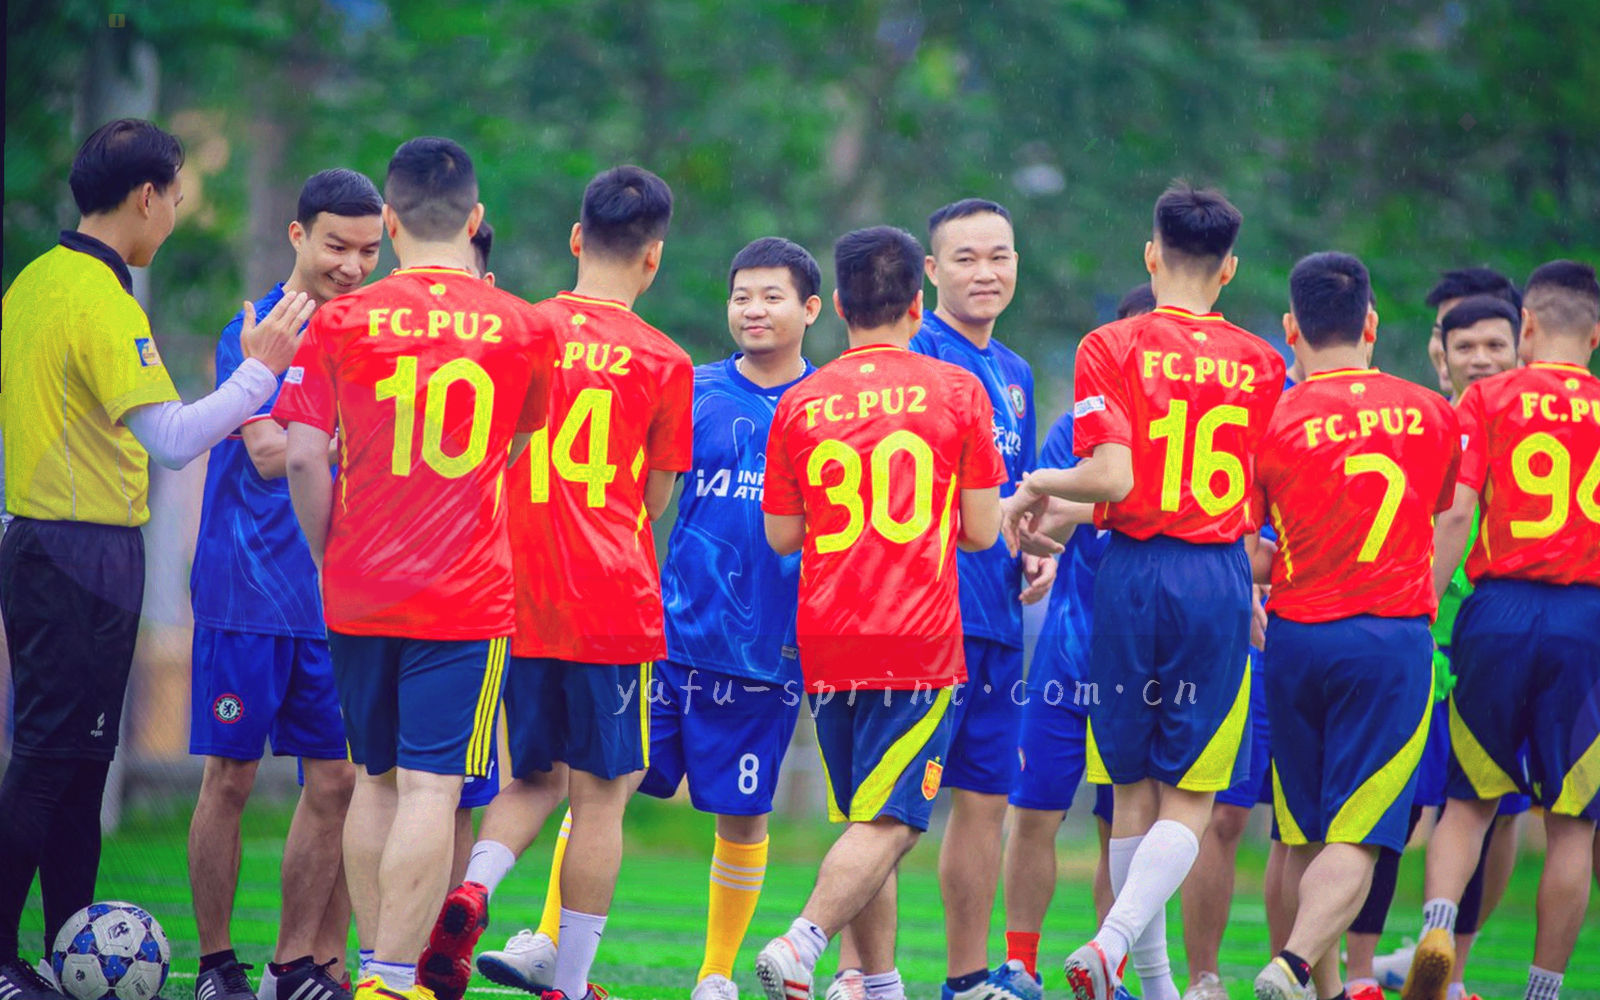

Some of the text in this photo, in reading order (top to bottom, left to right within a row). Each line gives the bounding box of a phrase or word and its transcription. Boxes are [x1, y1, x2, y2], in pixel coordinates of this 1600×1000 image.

[366, 307, 503, 344] FC.PU2
[1141, 350, 1256, 393] FC.PU2
[375, 355, 495, 479] 10
[805, 385, 928, 428] FC.PU2
[1303, 406, 1425, 448] FC.PU2
[1148, 398, 1249, 517] 16
[806, 428, 934, 555] 30
[1344, 452, 1407, 563] 7
[738, 753, 759, 795] 8
